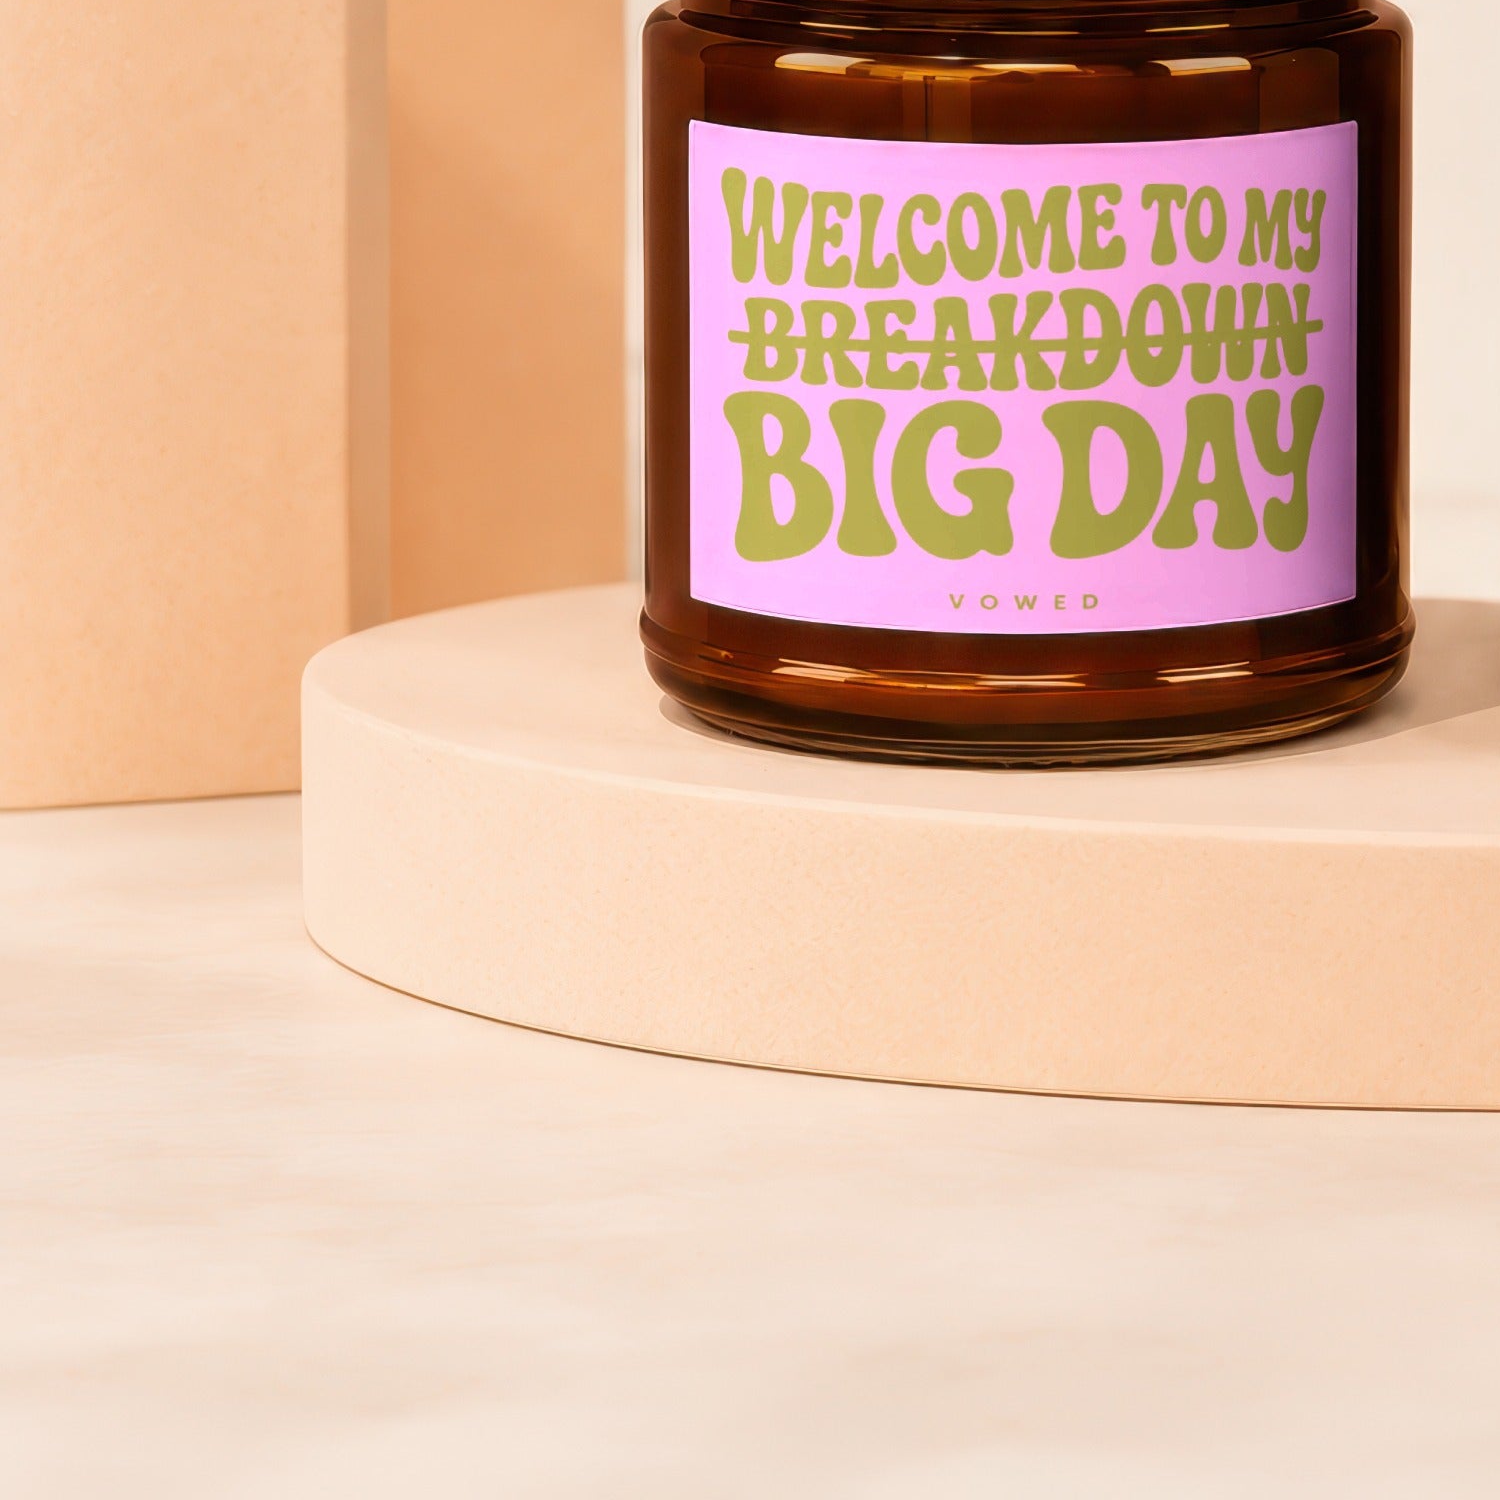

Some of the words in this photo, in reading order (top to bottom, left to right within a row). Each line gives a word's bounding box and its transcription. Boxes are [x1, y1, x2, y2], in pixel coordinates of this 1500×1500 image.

[720, 166, 1127, 289] WELCOME
[1141, 183, 1227, 266] TO
[1237, 187, 1327, 273] MY
[742, 282, 1313, 392] BREAKDOWN
[723, 390, 1015, 563] BIG
[1041, 384, 1325, 560] DAY
[949, 593, 1100, 611] VOWED
